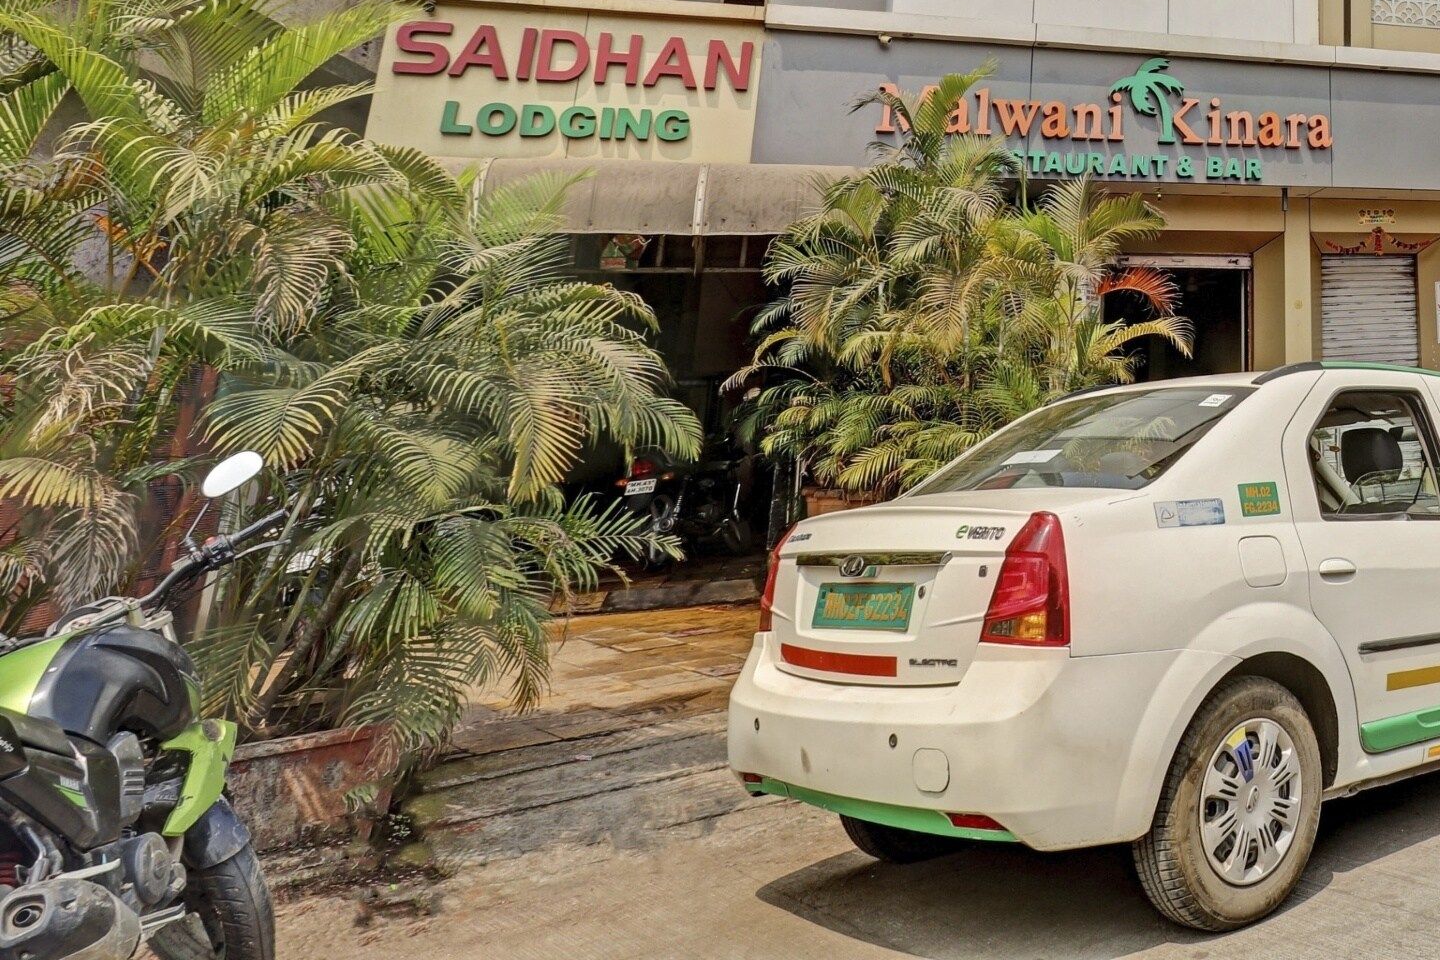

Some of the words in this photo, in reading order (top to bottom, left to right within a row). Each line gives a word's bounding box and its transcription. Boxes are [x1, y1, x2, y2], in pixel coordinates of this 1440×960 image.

[392, 21, 754, 92] SAIDHAN
[440, 100, 690, 141] LODGING
[1160, 96, 1333, 149] Kinara
[1176, 154, 1195, 178] &
[1206, 156, 1263, 181] BAR
[1245, 487, 1271, 498] MH.02
